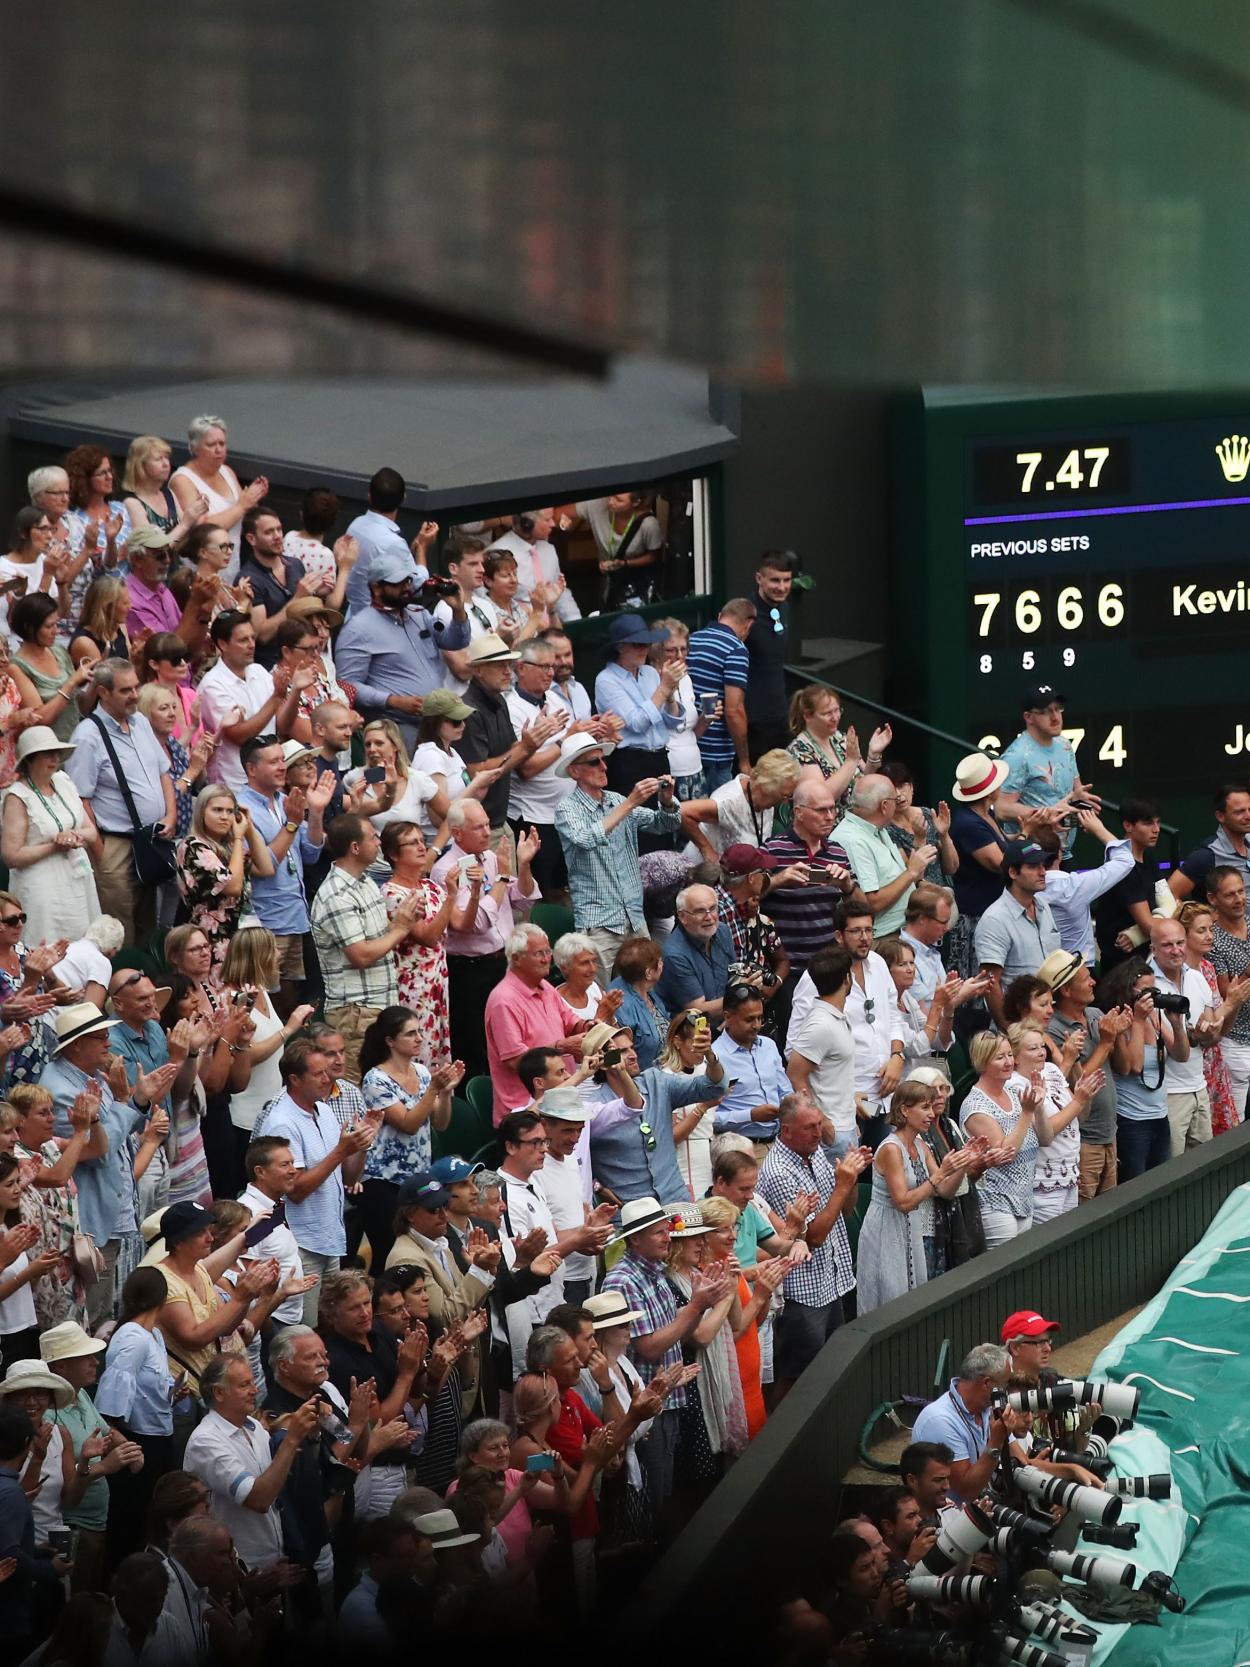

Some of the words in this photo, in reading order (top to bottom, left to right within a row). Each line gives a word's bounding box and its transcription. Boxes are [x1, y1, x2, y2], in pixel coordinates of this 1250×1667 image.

[1016, 447, 1110, 493] 7.47
[970, 538, 1048, 558] PREVIOUS
[1050, 535, 1090, 553] SETS
[973, 592, 1001, 637] 7
[1015, 589, 1042, 634] 6
[1057, 586, 1084, 630] 6
[1097, 583, 1125, 627] 6
[979, 654, 993, 674] 8
[1022, 650, 1035, 670] 5
[1062, 647, 1076, 667] 9
[1098, 724, 1128, 768] 4
